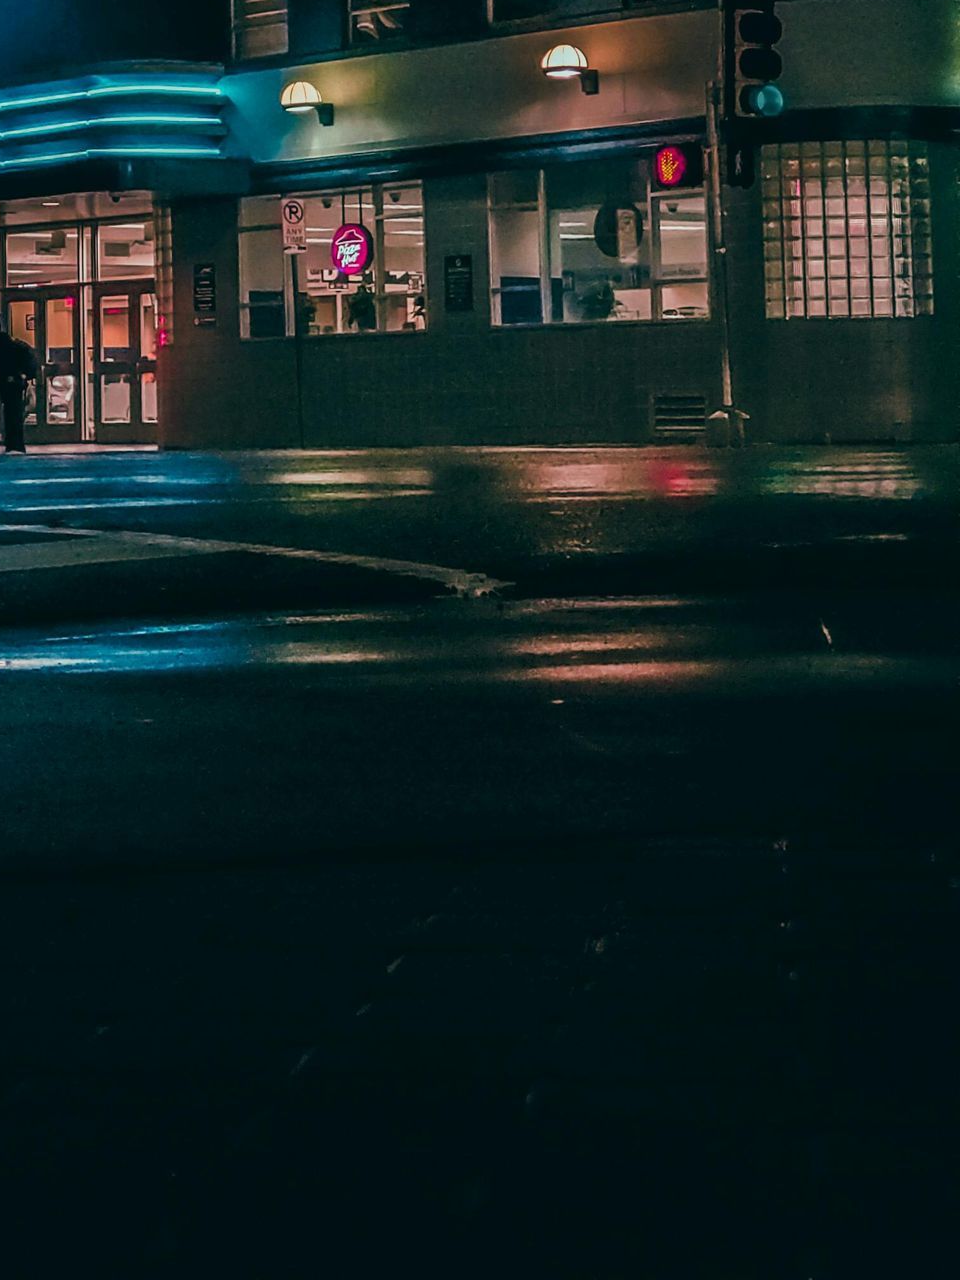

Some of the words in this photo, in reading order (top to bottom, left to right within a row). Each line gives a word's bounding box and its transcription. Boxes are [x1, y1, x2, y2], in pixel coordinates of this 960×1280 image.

[286, 236, 303, 244] TIME
[337, 243, 361, 260] Pizza
[341, 253, 359, 268] Hut
